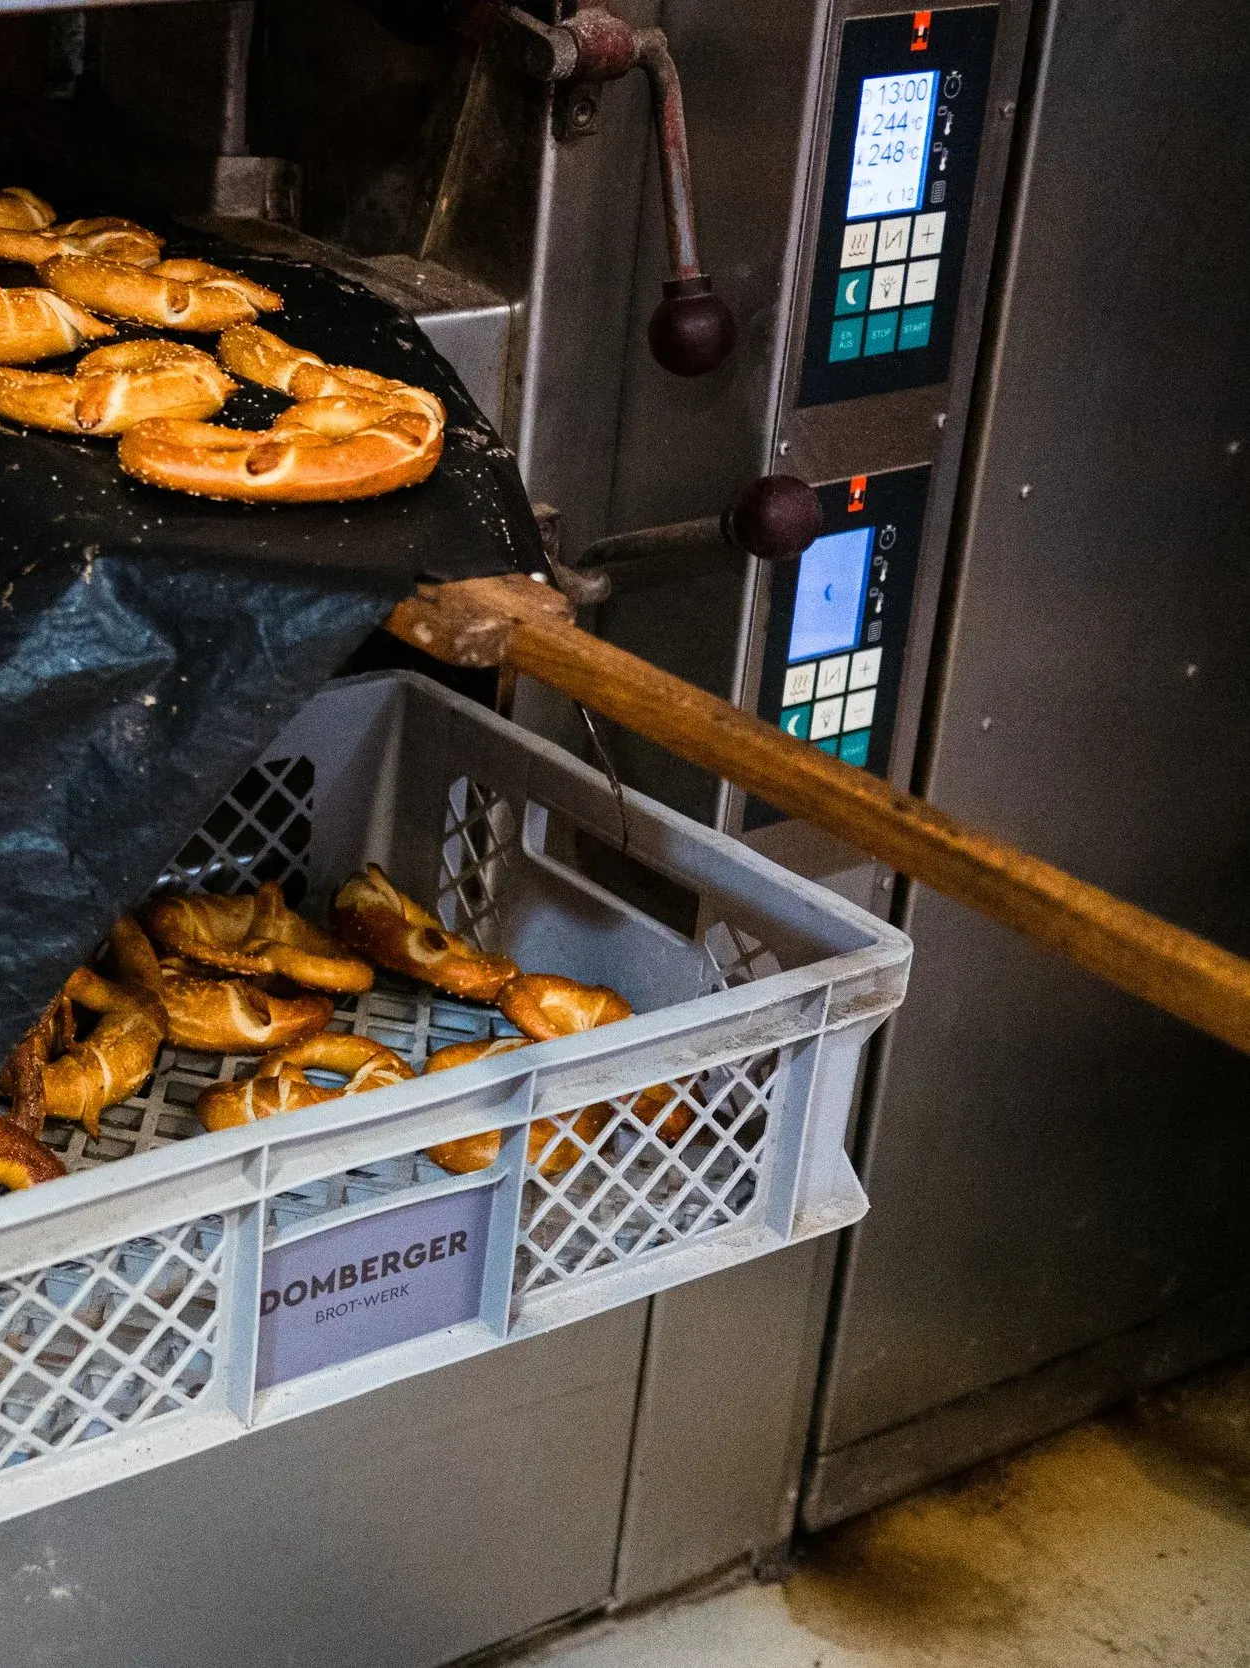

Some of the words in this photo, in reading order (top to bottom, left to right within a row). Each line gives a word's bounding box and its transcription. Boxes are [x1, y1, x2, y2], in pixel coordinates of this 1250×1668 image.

[879, 78, 928, 106] 13:00
[872, 111, 908, 136] 244
[868, 140, 905, 166] 248
[901, 187, 915, 201] 12
[871, 328, 892, 340] STOP
[903, 322, 928, 334] START
[260, 1230, 468, 1317] DOMBERGER
[315, 1283, 410, 1324] BROT-WERK
